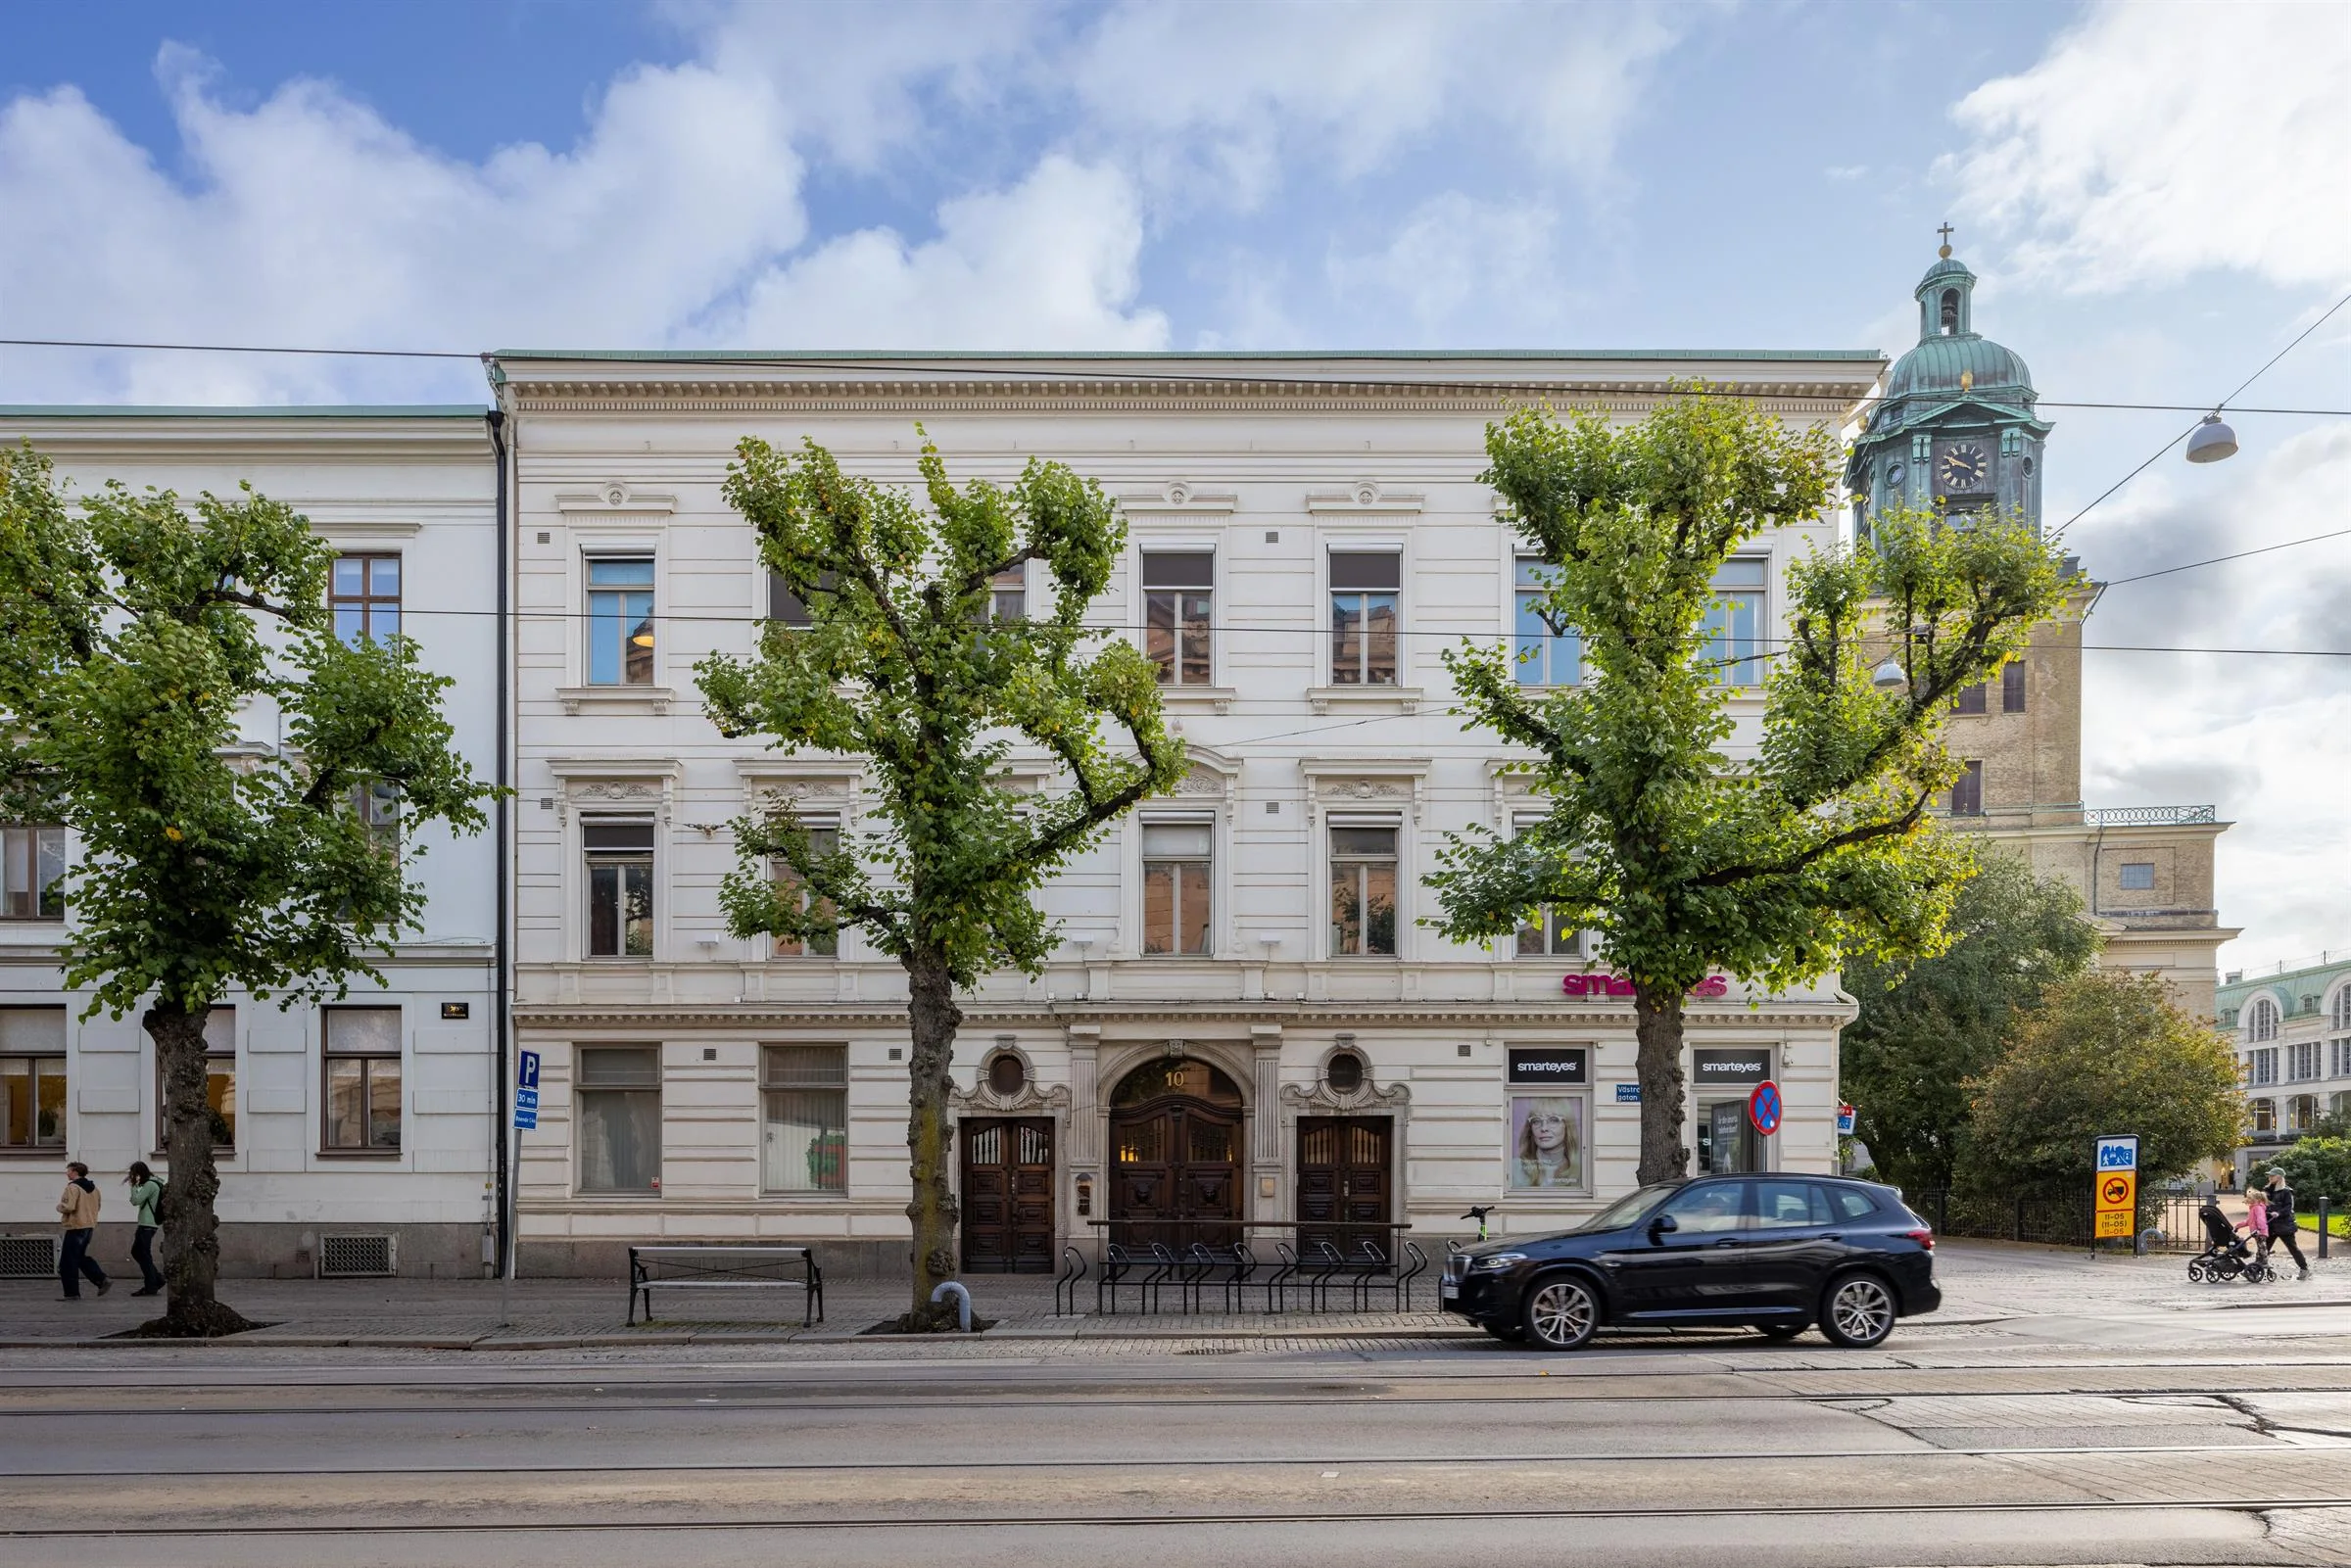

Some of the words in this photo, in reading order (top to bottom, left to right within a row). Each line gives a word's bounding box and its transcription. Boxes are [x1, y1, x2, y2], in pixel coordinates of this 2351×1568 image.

[525, 1055, 536, 1083] P
[1517, 1062, 1577, 1072] smarteyes
[1703, 1062, 1762, 1073] smarteyes
[1166, 1071, 1183, 1086] 10
[517, 1093, 526, 1103] 30
[527, 1096, 536, 1105] min
